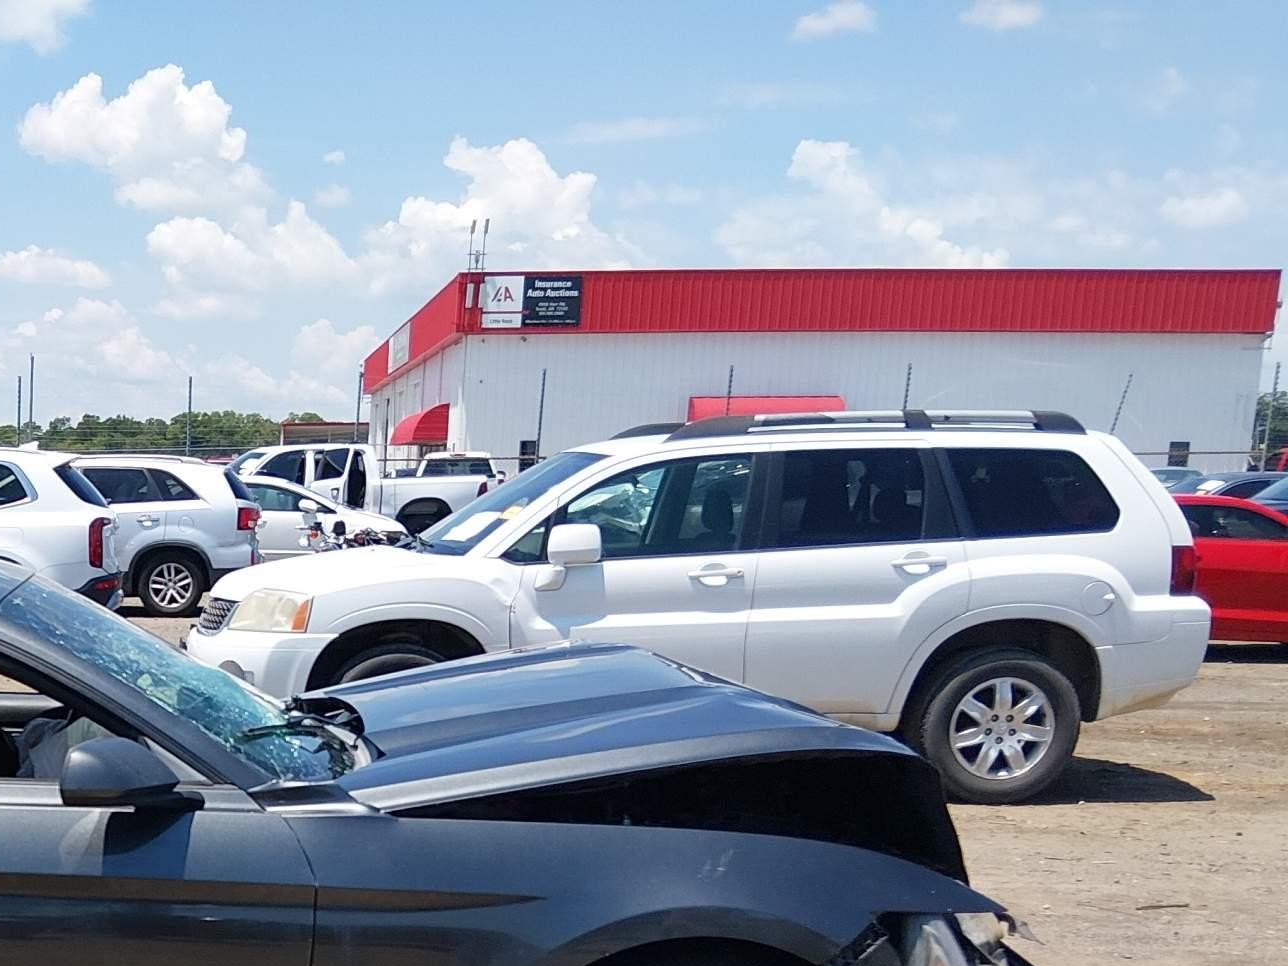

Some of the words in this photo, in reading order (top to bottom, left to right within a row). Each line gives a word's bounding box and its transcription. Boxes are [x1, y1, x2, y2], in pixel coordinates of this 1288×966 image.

[535, 280, 572, 288] Insurance
[527, 289, 544, 297] Auto
[546, 289, 579, 297] Auctions
